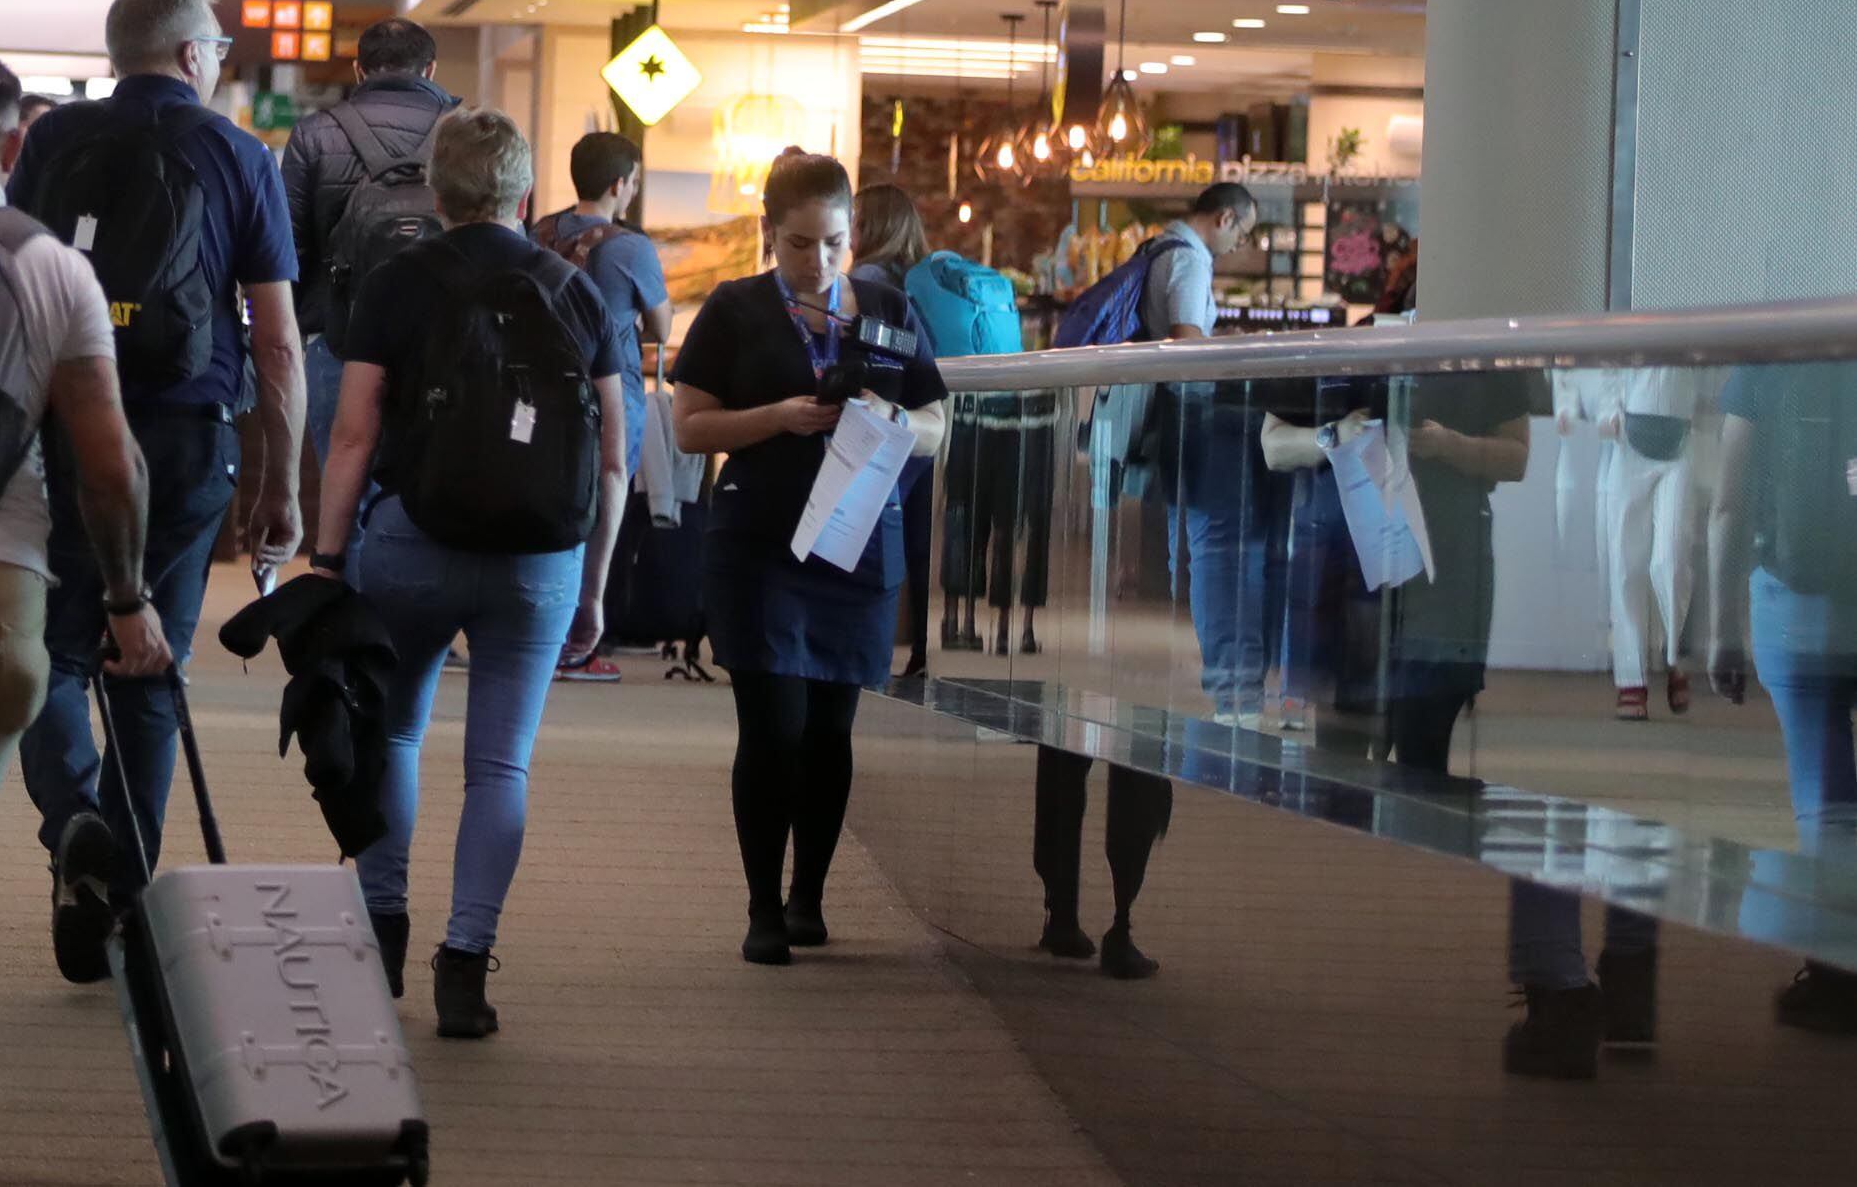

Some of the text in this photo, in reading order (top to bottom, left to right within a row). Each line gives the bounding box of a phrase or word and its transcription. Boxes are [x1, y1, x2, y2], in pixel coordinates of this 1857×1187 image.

[1070, 152, 1214, 184] california
[1221, 154, 1308, 185] pizza
[109, 301, 135, 327] AT
[254, 883, 350, 1112] NAUTICA
